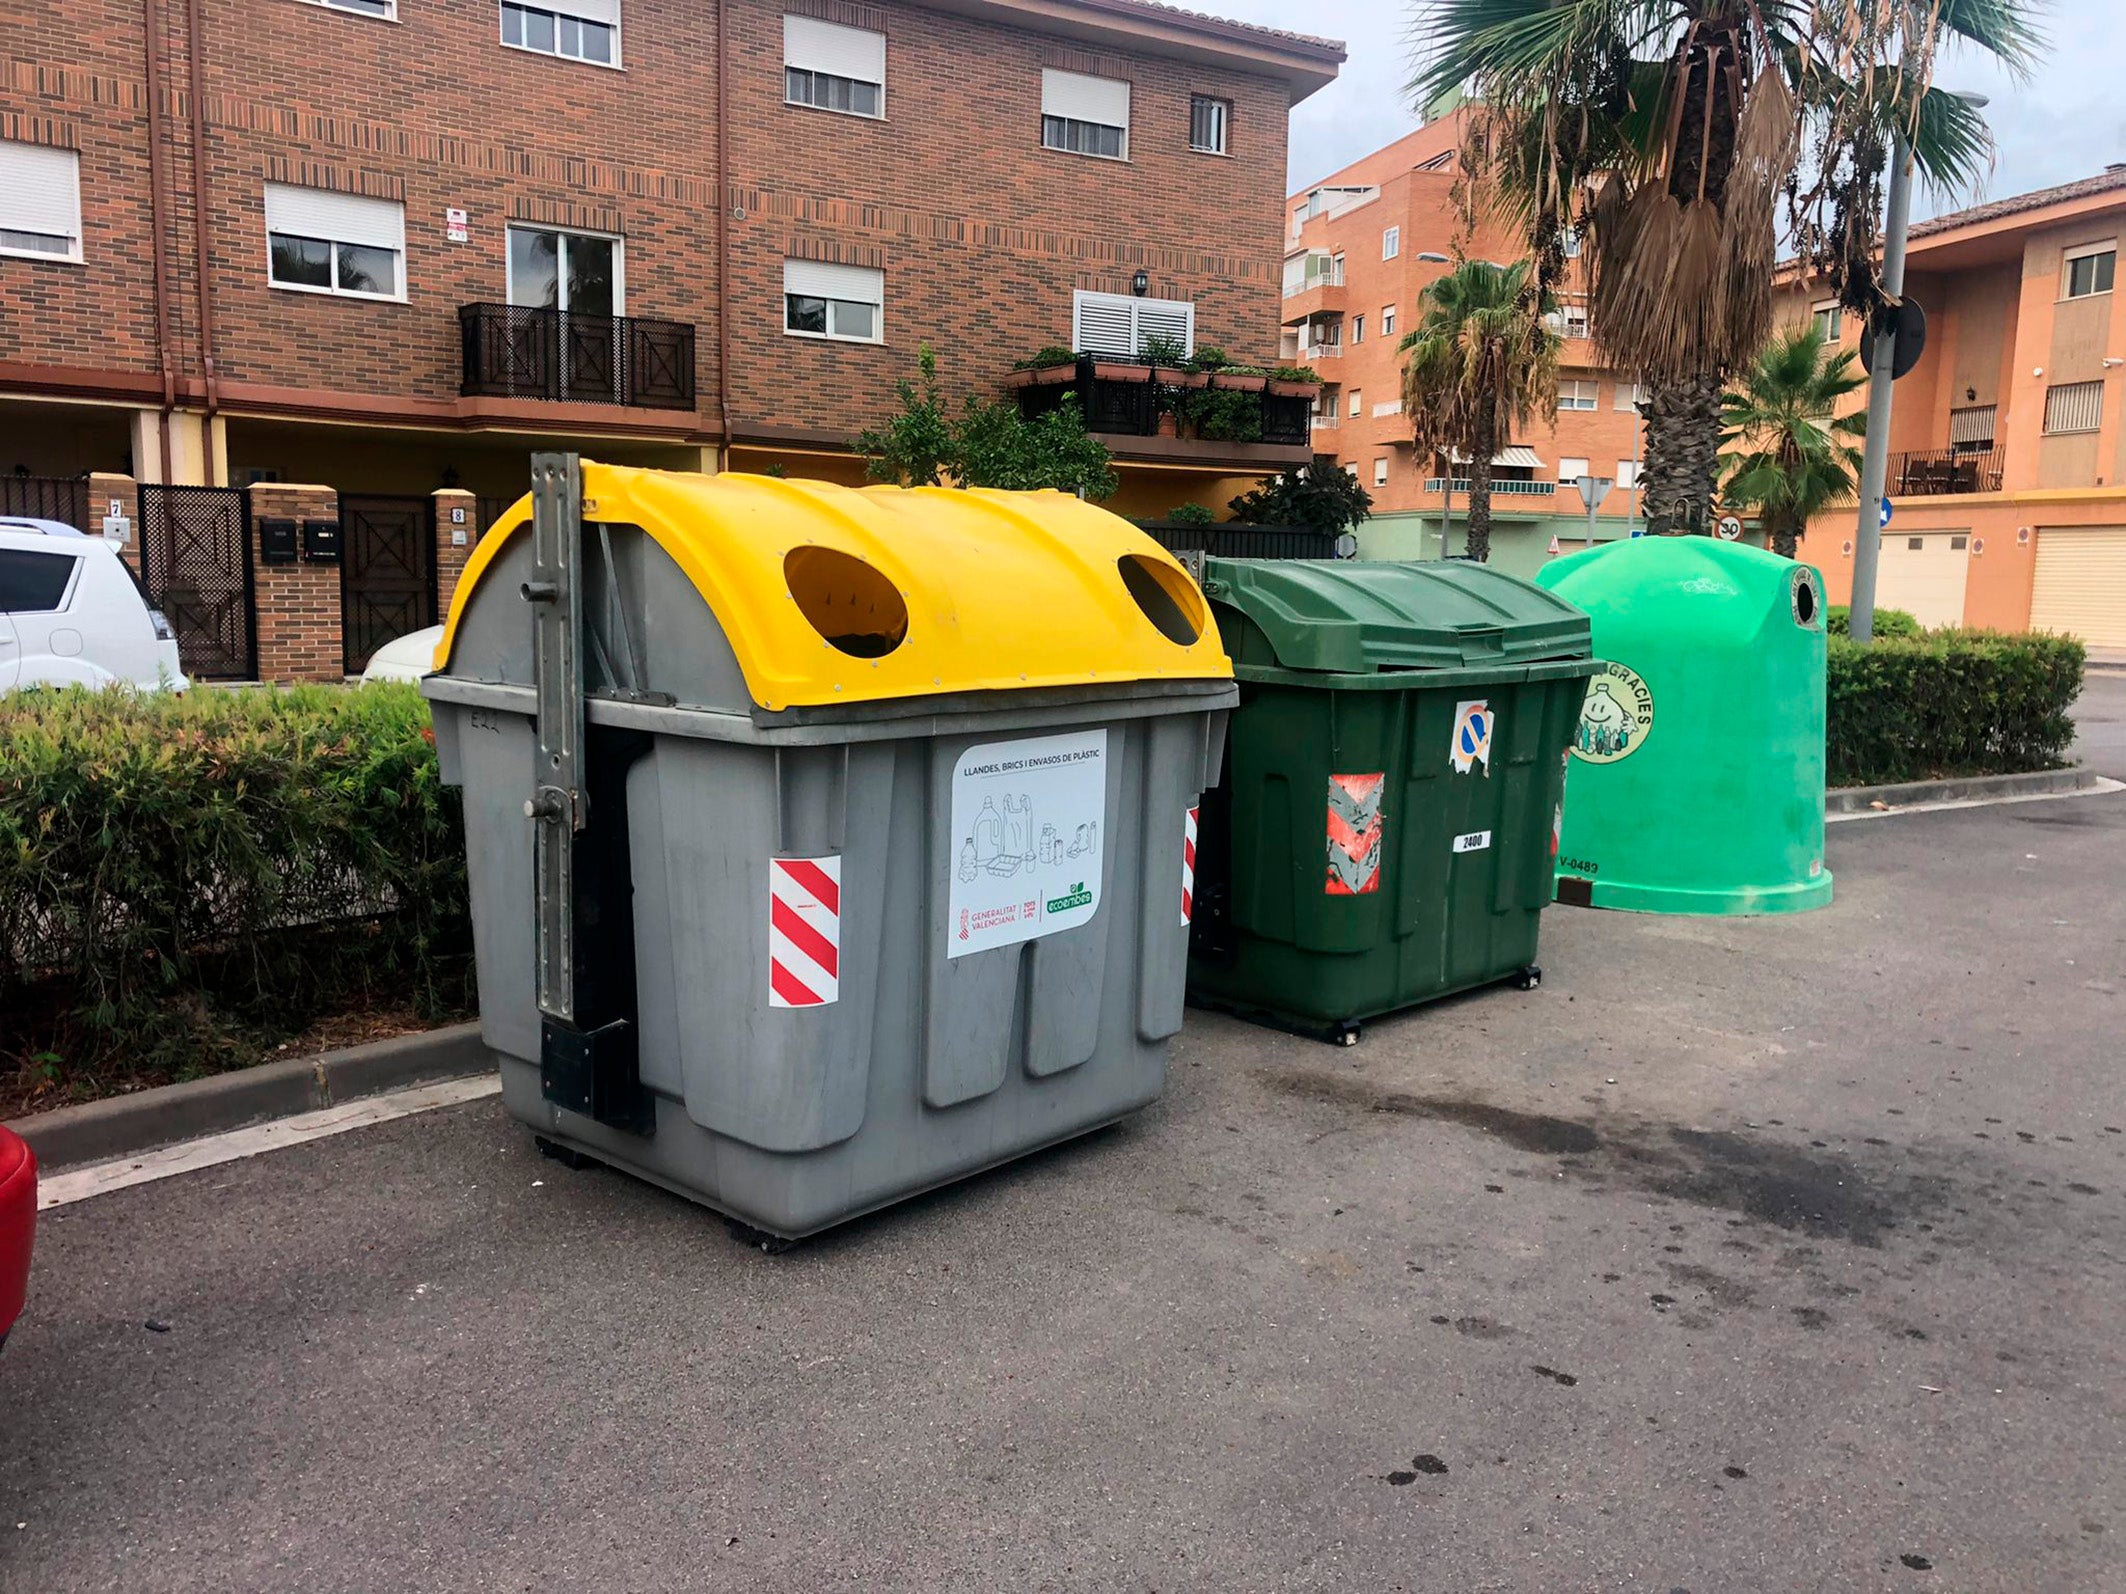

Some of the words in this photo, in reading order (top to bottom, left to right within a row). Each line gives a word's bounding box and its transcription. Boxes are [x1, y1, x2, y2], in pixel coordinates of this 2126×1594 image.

[112, 504, 119, 514] 7
[455, 511, 462, 521] 8
[1721, 523, 1739, 535] 30
[1609, 663, 1652, 725] GRACIES
[964, 763, 1000, 776] LLANDES,
[1002, 760, 1023, 771] BRICS
[1029, 754, 1061, 767] ENVASOS
[1062, 753, 1072, 762] DE
[1463, 834, 1482, 848] 2400
[1560, 856, 1599, 873] V-0489
[971, 904, 1016, 921] GENERALITAT
[972, 915, 1015, 930] VALENCIANA
